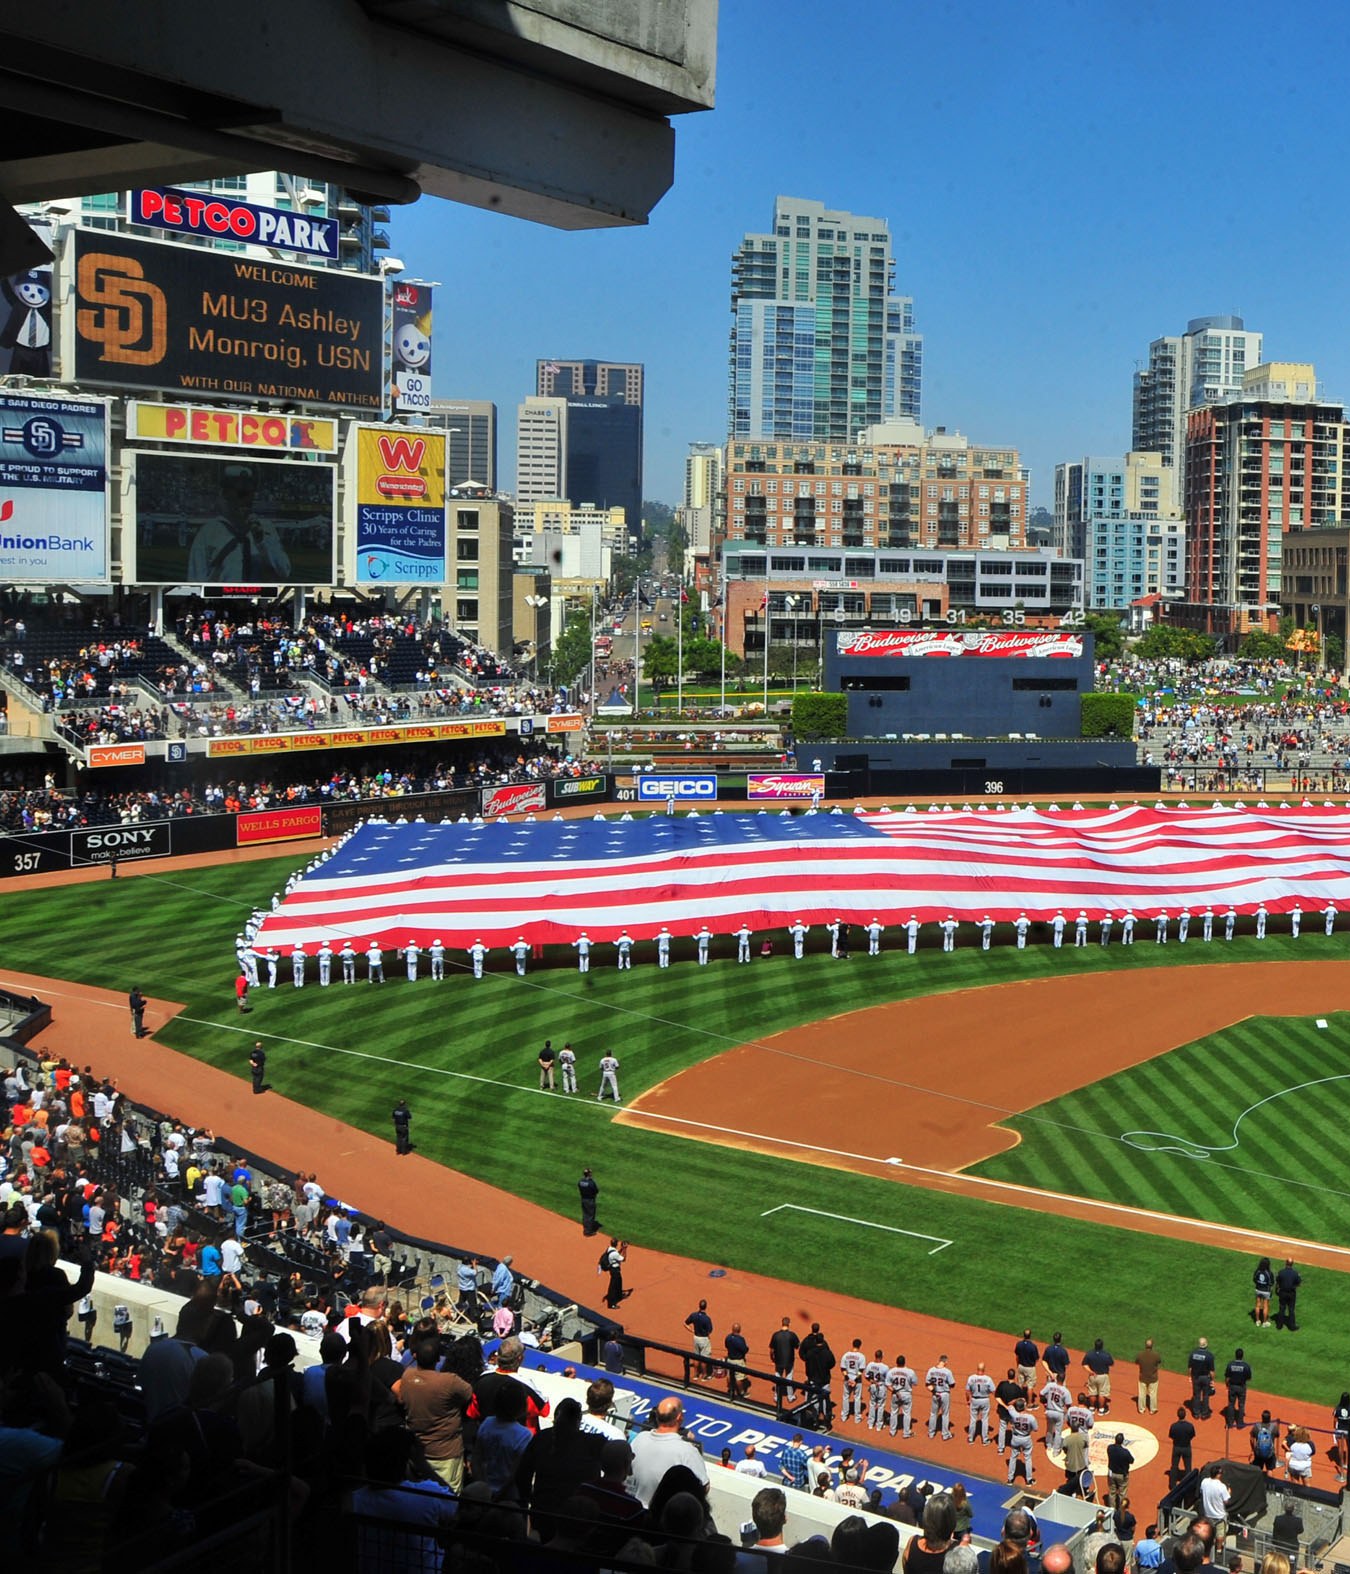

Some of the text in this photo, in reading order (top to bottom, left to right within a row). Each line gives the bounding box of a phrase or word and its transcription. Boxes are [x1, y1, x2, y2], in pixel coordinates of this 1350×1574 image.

[140, 190, 331, 253] PETCO PARK
[234, 263, 318, 291] WELCOME
[201, 291, 361, 341] MU3 Ashley
[189, 327, 371, 372] Monroig, USN
[180, 374, 380, 407] WITH OUR NATIONAL ANTHEM
[407, 378, 422, 392] GO
[401, 392, 430, 407] TACOS
[8, 400, 29, 408] SAN
[31, 401, 58, 410] DIEGO
[61, 404, 97, 414] PADRES
[165, 409, 287, 447] PETCO
[378, 435, 426, 472] W
[8, 464, 41, 474] PROUD
[43, 466, 55, 474] TO
[57, 467, 98, 477] SUPPORT
[2, 472, 84, 485] THE U.S. MILITARY
[362, 508, 441, 525] Scripps Clinic
[362, 523, 437, 537] 30 Years of Caring
[390, 538, 442, 548] for the Padres
[18, 556, 48, 570] in you
[833, 610, 846, 623] 6
[891, 609, 912, 624] 19
[946, 611, 966, 624] 31
[1003, 610, 1025, 624] 35
[1063, 611, 1086, 626] 42
[854, 632, 938, 653] Budweiser
[976, 633, 1061, 653] Budweiser
[441, 726, 465, 735] PETCO
[474, 724, 498, 732] PETCO
[549, 719, 580, 729] CYMER
[332, 733, 359, 743] PETCO
[371, 731, 396, 740] PETCO
[406, 728, 430, 738] PETCO
[211, 742, 240, 751] PETCO
[254, 740, 281, 748] PETCO
[294, 736, 321, 746] PETCO
[91, 749, 144, 764] CYMER
[561, 780, 600, 794] SUBWAY
[642, 780, 714, 795] GEICO
[758, 777, 816, 796] Sycuan
[984, 781, 1004, 794] 396
[486, 785, 546, 813] Budweiser
[616, 790, 635, 800] 401
[240, 814, 319, 832] WELLS FARGO
[86, 829, 156, 849] SONY
[91, 846, 151, 860] mak.believe
[14, 852, 41, 872] 357
[849, 1360, 856, 1370] 2
[892, 1377, 906, 1387] 48
[977, 1384, 981, 1392] 1
[1050, 1392, 1060, 1403] 16
[685, 1413, 733, 1438] TO
[1014, 1422, 1028, 1431] 23
